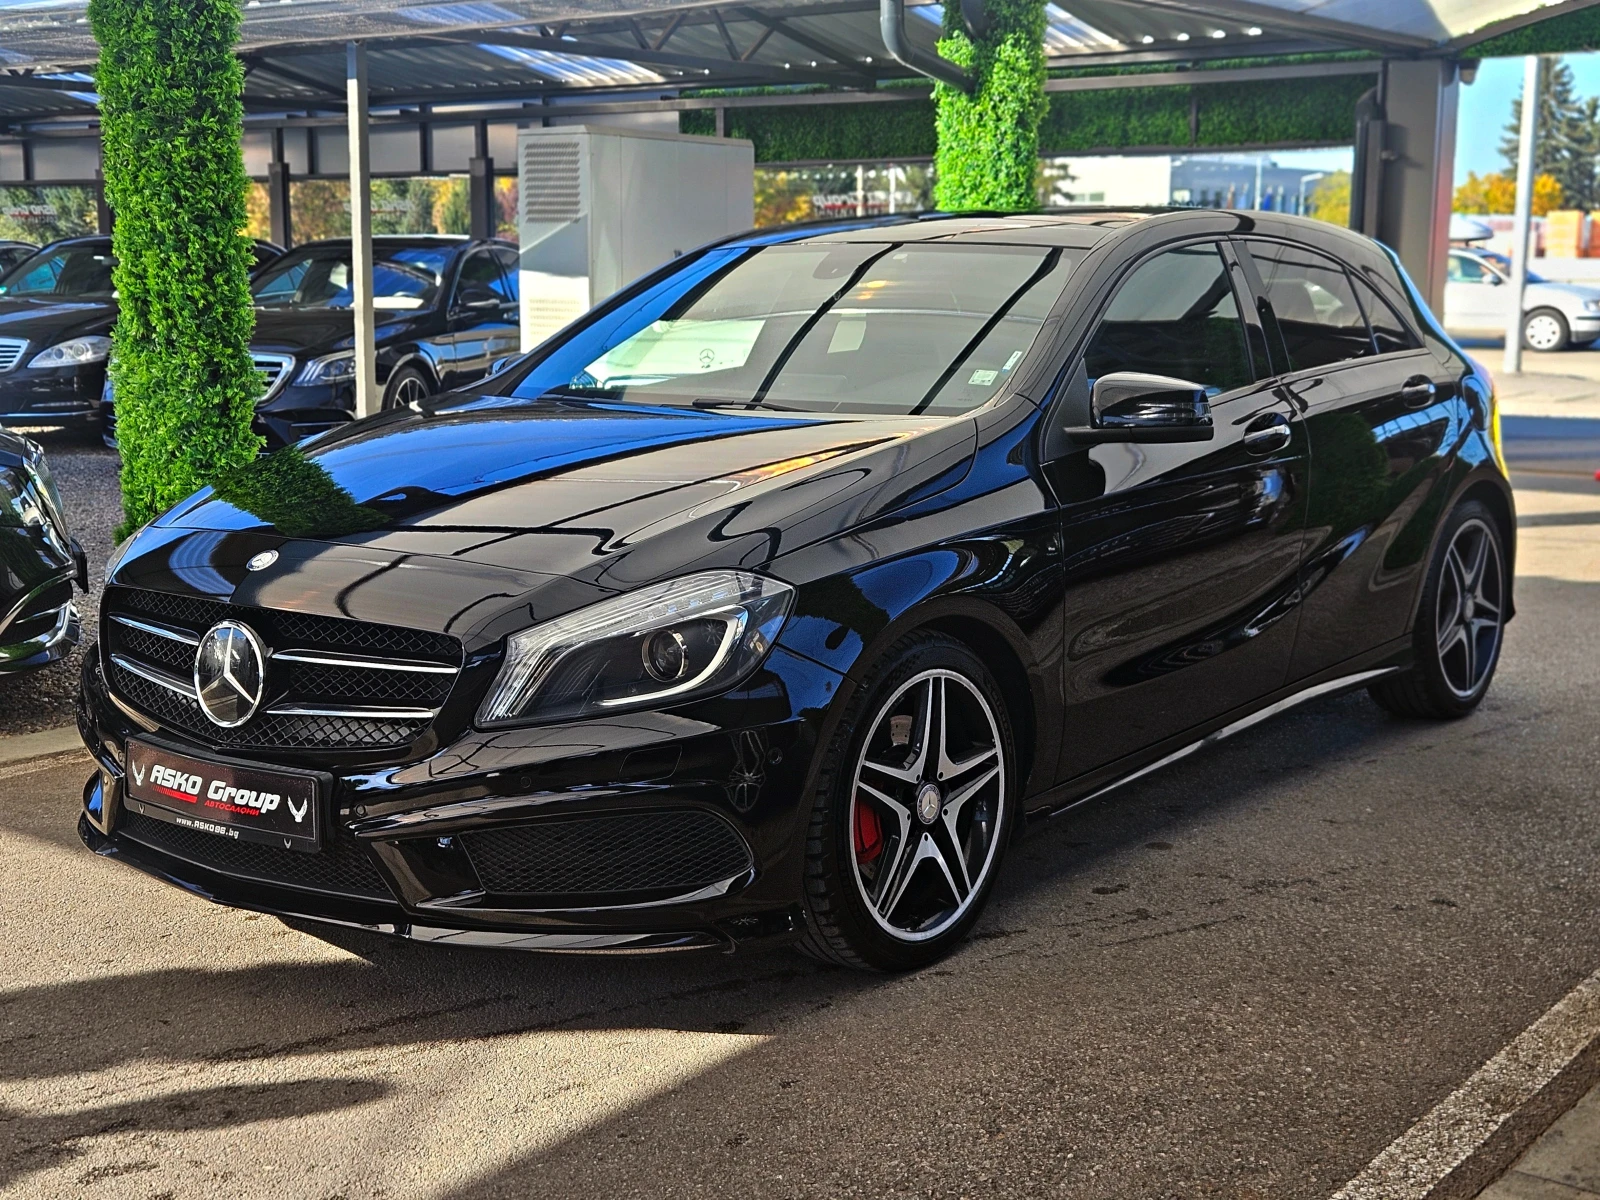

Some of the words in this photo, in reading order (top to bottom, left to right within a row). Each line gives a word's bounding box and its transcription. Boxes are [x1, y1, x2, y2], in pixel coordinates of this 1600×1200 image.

[150, 765, 202, 794] ASKO
[207, 780, 281, 814] Group
[204, 800, 260, 816] АВТОСАЛОНИ
